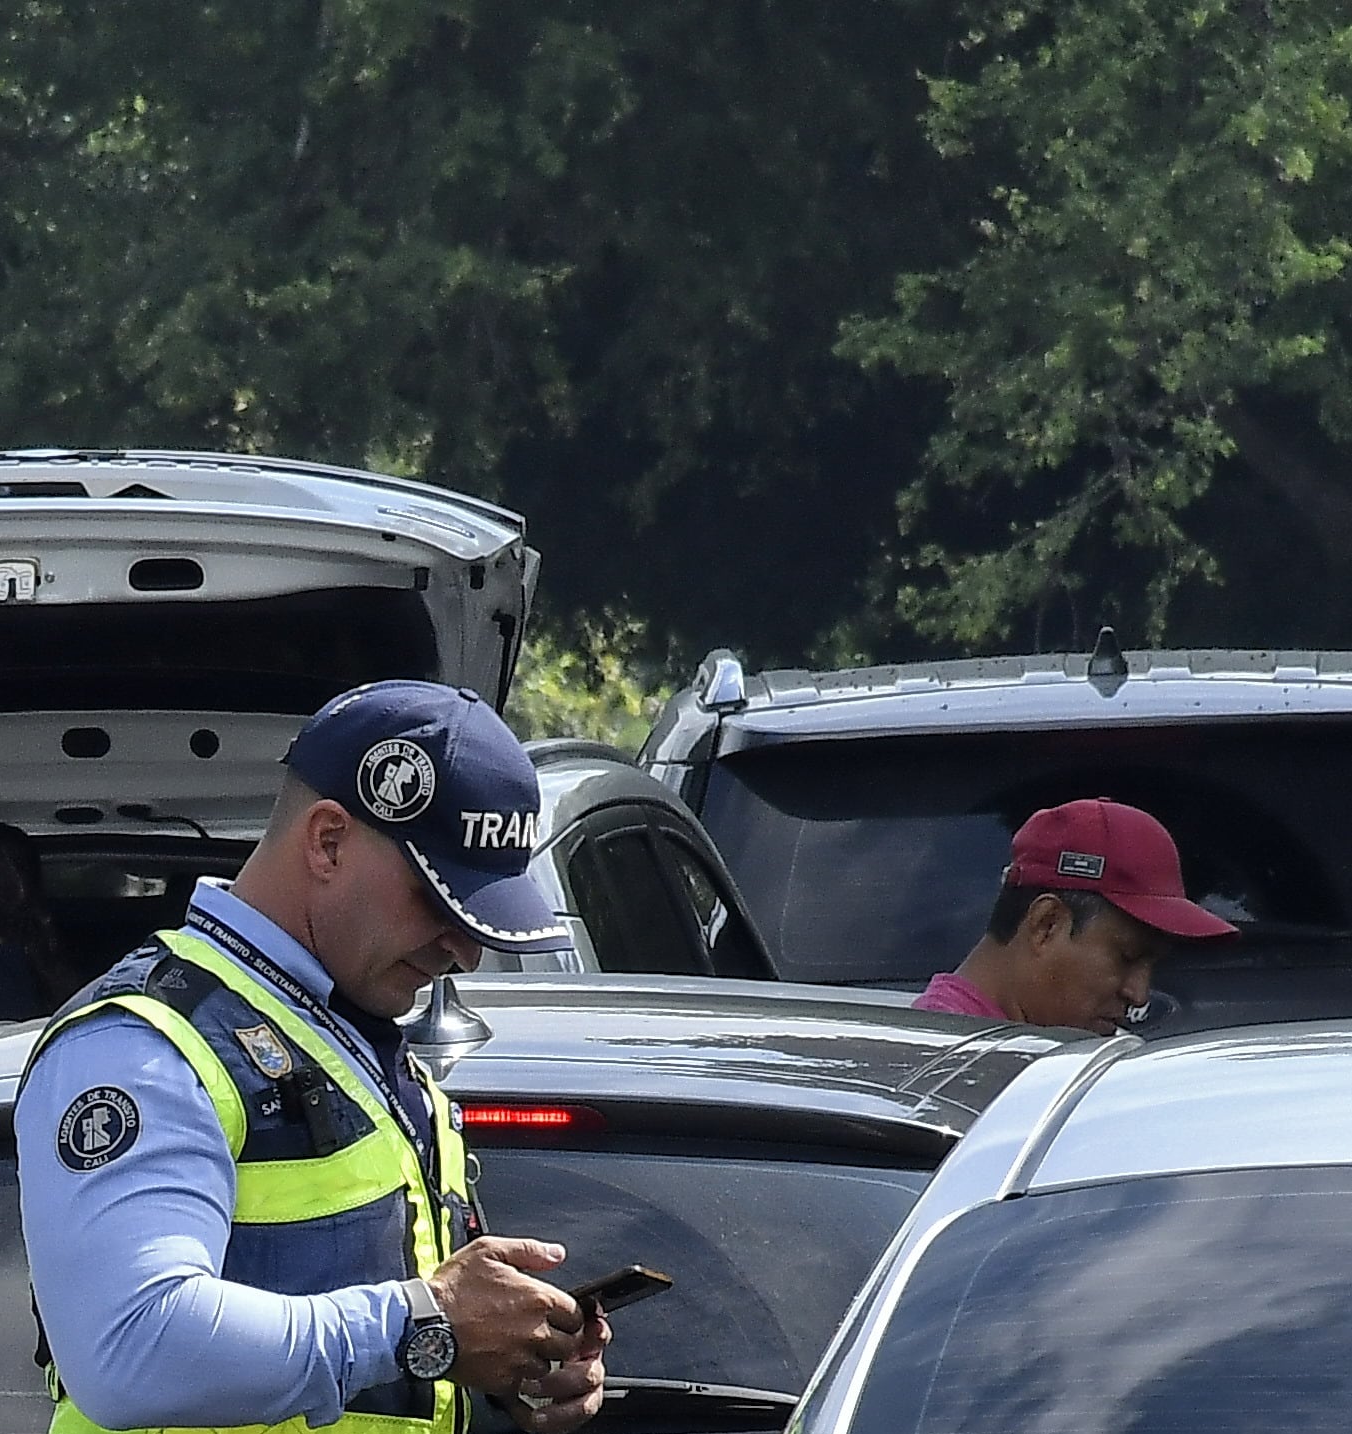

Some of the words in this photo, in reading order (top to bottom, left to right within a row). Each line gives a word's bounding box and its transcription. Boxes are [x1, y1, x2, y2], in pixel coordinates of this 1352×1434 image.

[372, 801, 395, 818] CALI
[212, 925, 252, 958] TRANSITO
[86, 1090, 101, 1102] DE
[83, 1154, 110, 1169] CALI
